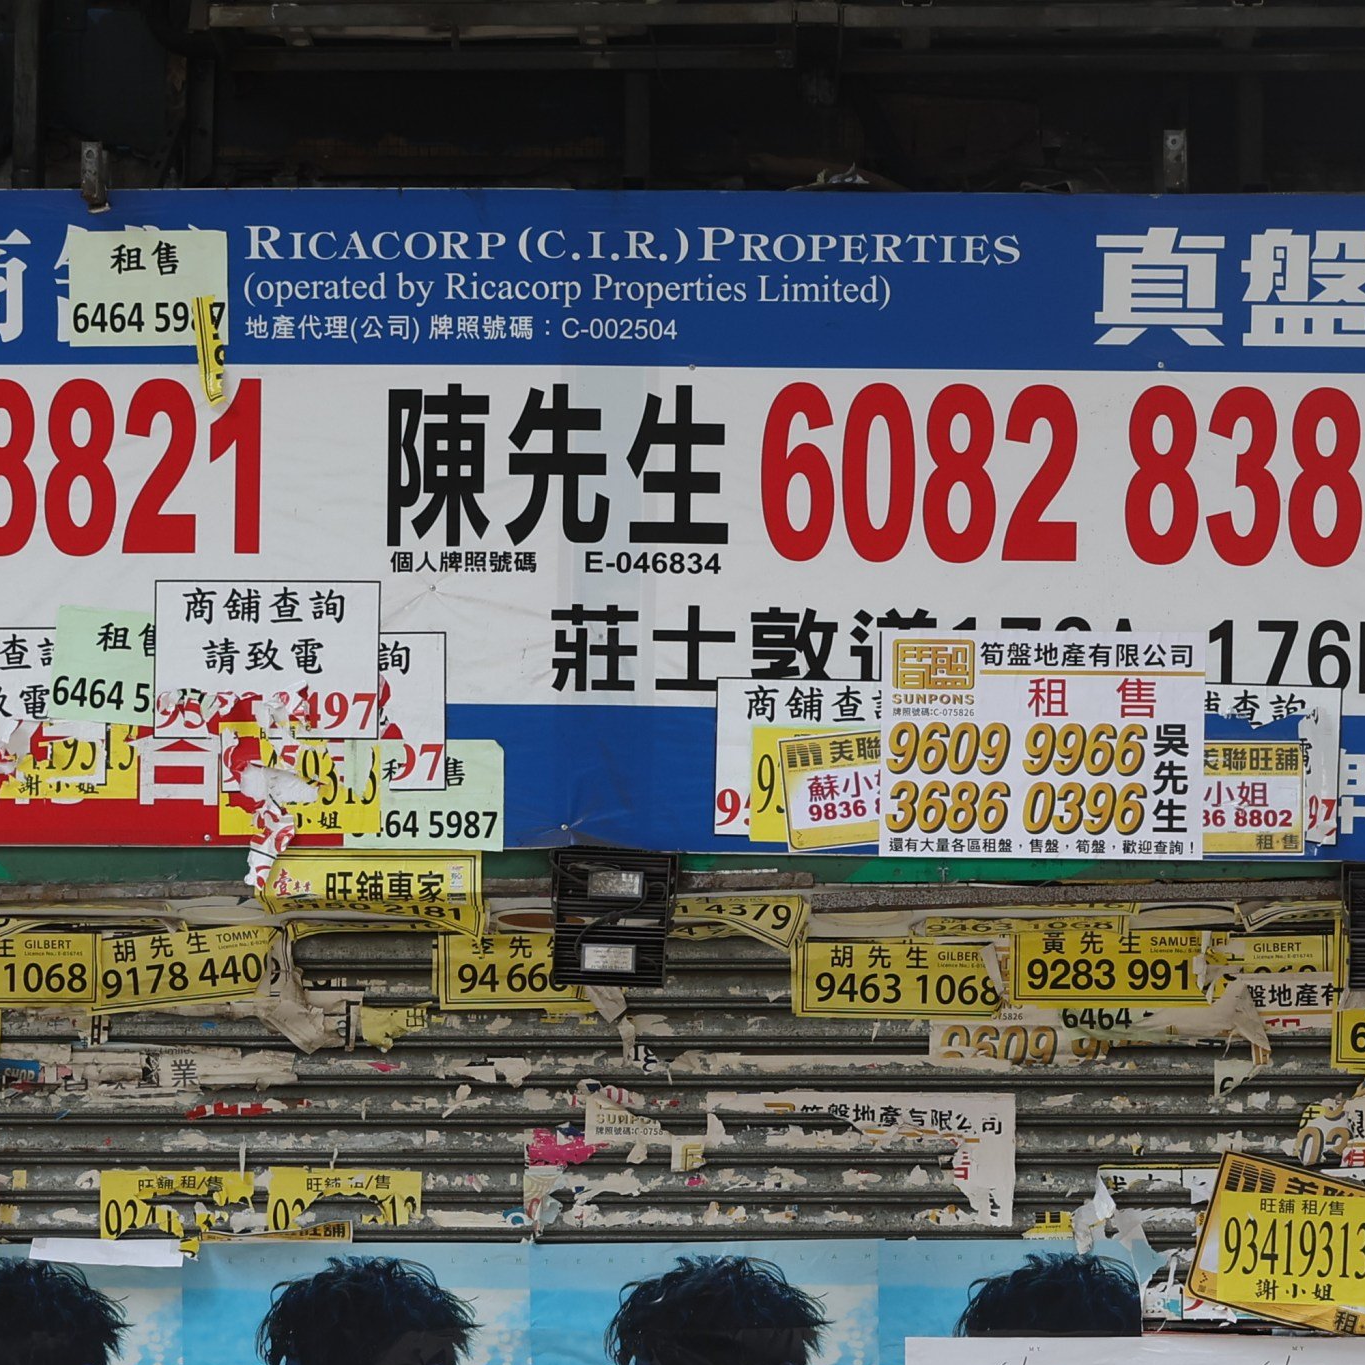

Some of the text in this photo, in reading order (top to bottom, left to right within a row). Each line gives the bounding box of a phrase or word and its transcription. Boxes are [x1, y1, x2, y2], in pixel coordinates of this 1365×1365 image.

[110, 240, 180, 275] 租售
[244, 225, 1021, 265] RICACORP (C.I.R.) PROPERTIES
[244, 272, 891, 310] (operated by Ricacorp Properties Limited)
[73, 303, 145, 334] 6464
[244, 315, 421, 342] 地產代理(公司)
[386, 383, 730, 547] 陳先生
[760, 382, 1078, 563] 6082
[390, 550, 722, 575] 個人牌照號碼 E-046834
[182, 586, 347, 626] 商舖查詢
[202, 638, 324, 675] 請致電
[980, 642, 1194, 668] 筍盤地產有限公司
[892, 694, 975, 706] SUNPONS
[885, 722, 1148, 776] 9609 9966
[1152, 724, 1190, 834] 吳先生
[885, 780, 1148, 835] 3686 0396
[1234, 809, 1293, 829] 8802
[430, 811, 498, 838] 5987
[24, 938, 72, 950] GILBERT
[113, 929, 260, 963] 胡先生 TOMMY
[829, 945, 930, 970] 胡先生
[1041, 931, 1144, 956] 黃先生
[4, 963, 88, 994] 1068
[101, 962, 190, 1000] 9178
[815, 972, 1002, 1006] 9463 1068
[1026, 958, 1115, 991] 9283
[1260, 1197, 1346, 1216] 旺舖 租/售
[1255, 1279, 1337, 1301] 謝小姐
